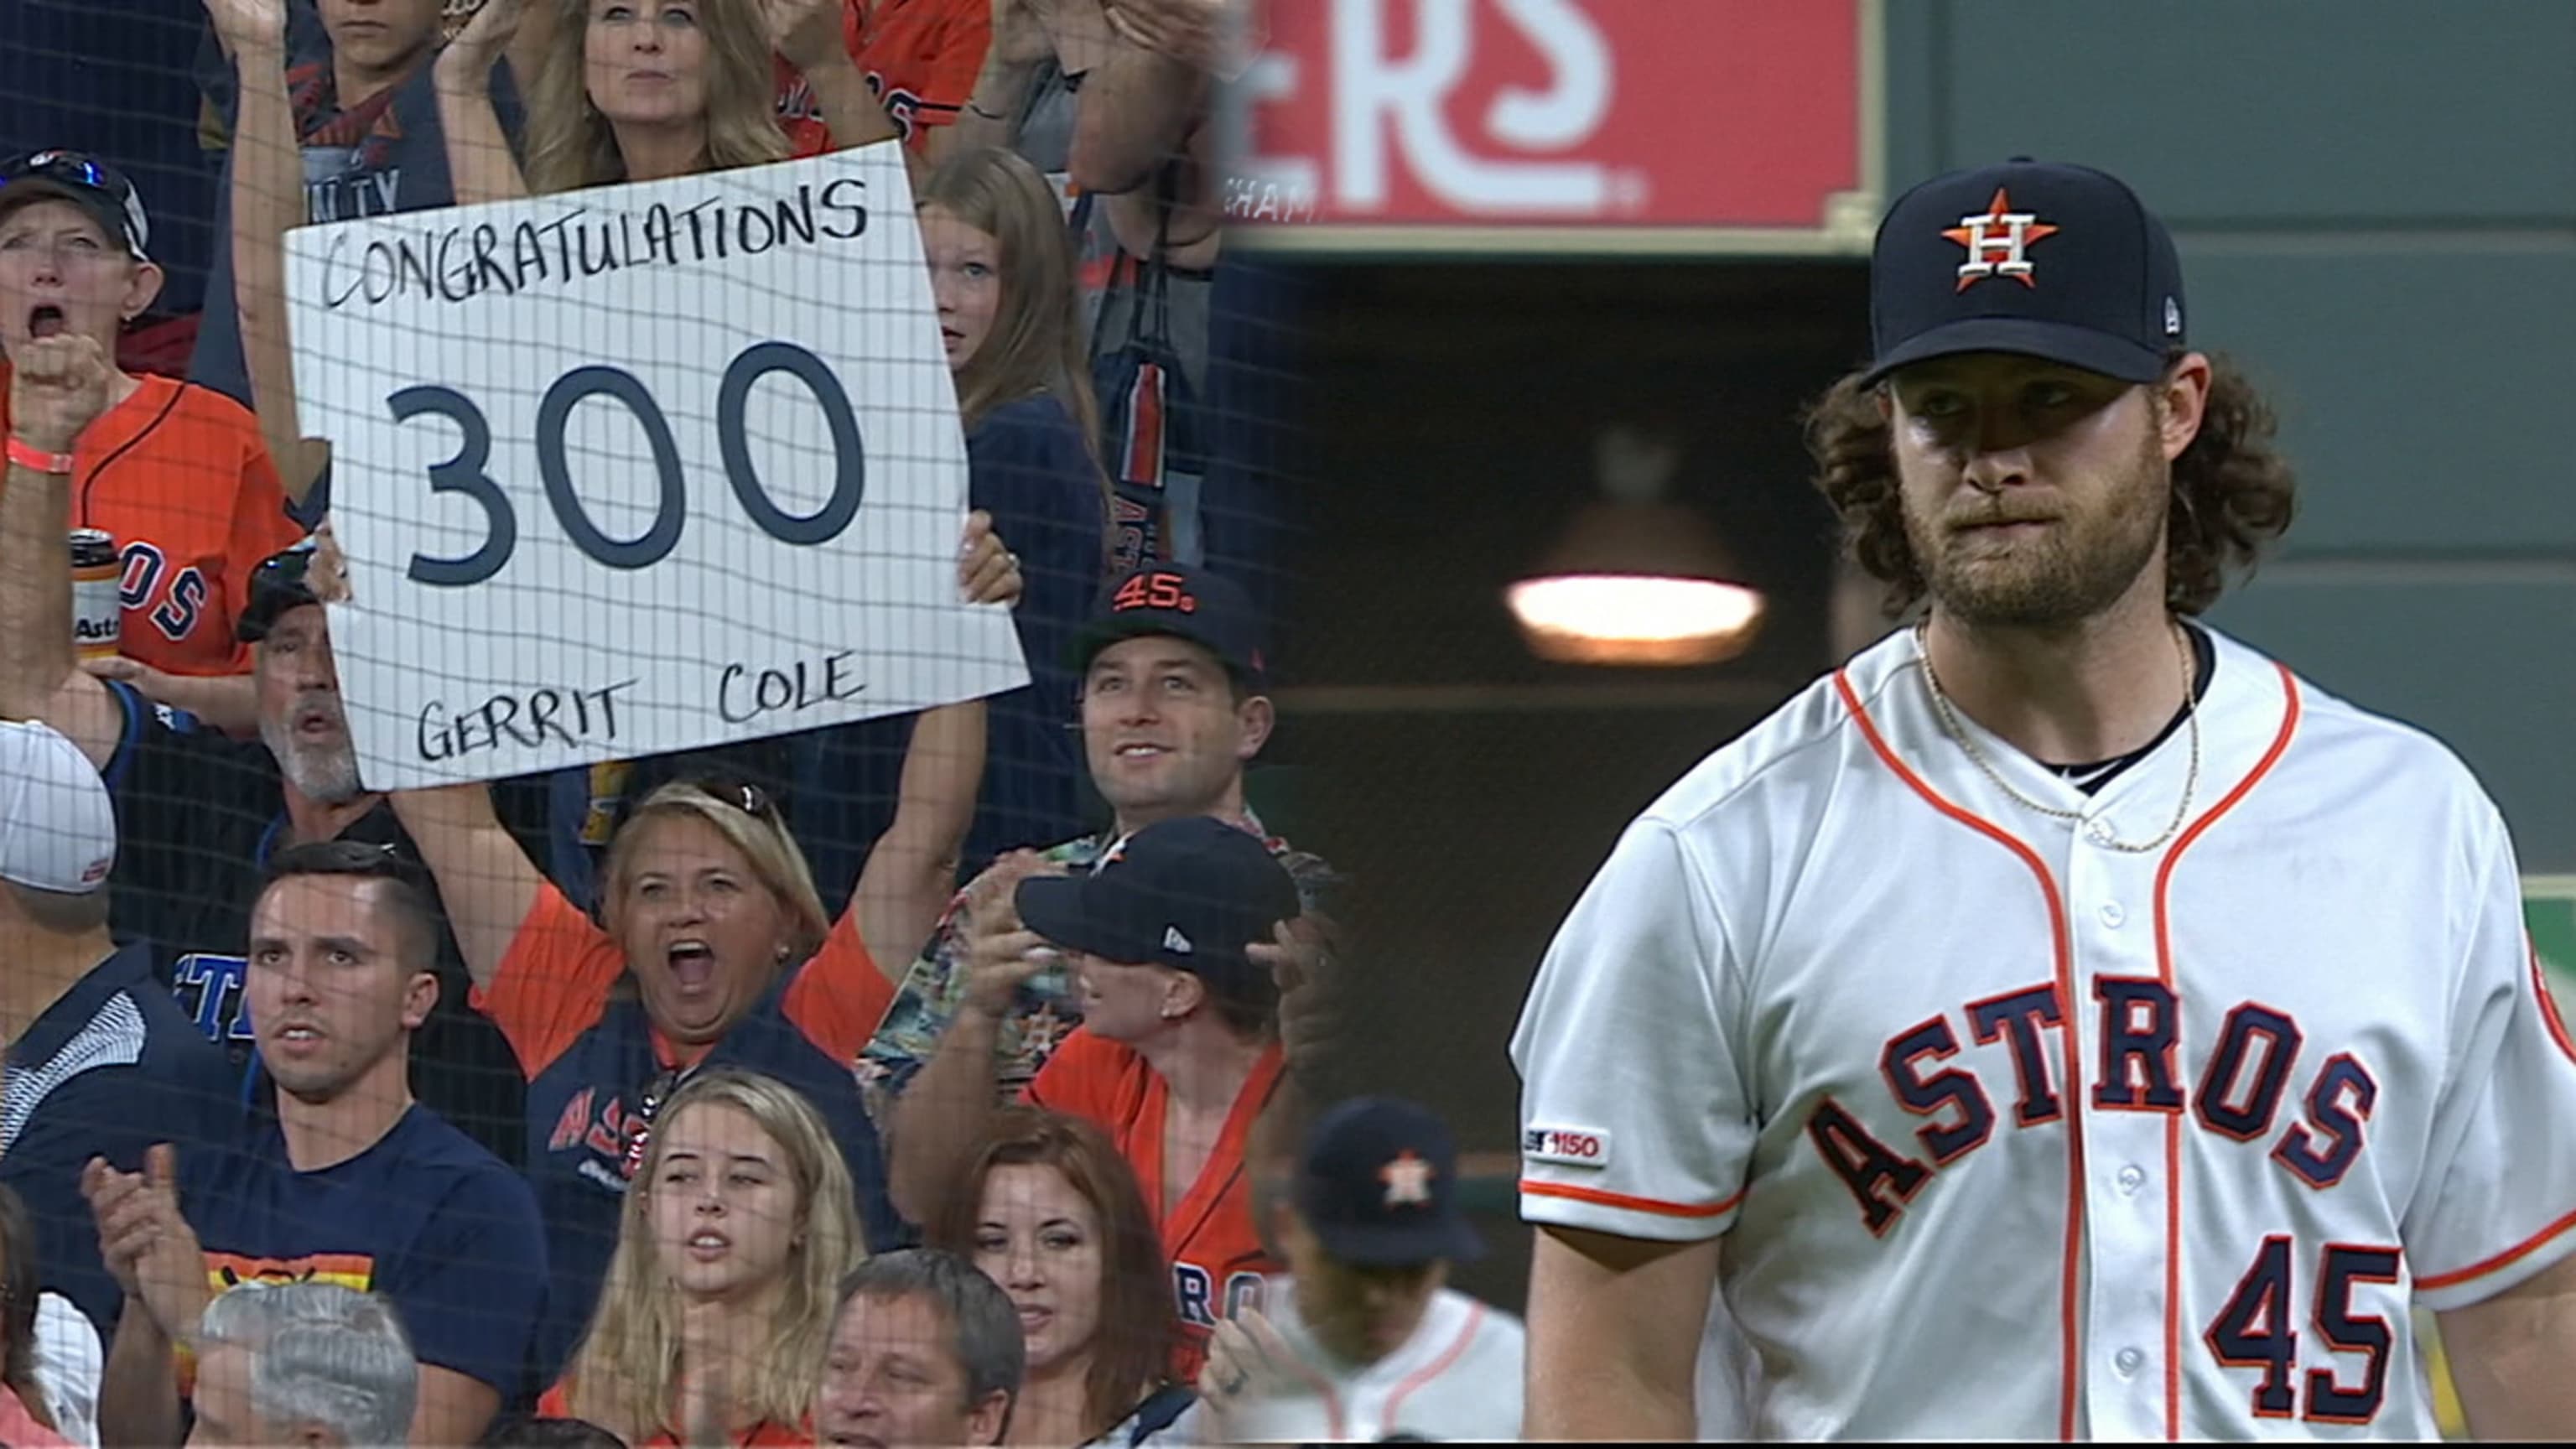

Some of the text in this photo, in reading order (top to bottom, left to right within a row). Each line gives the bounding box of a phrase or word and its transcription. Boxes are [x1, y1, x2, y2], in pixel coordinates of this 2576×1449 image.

[322, 179, 867, 309] CONGRATULATIONS
[386, 340, 865, 588] 300
[418, 651, 867, 762] GERRIT COLE
[1806, 973, 2378, 1239] ASTROS
[2204, 1234, 2403, 1425] 45
